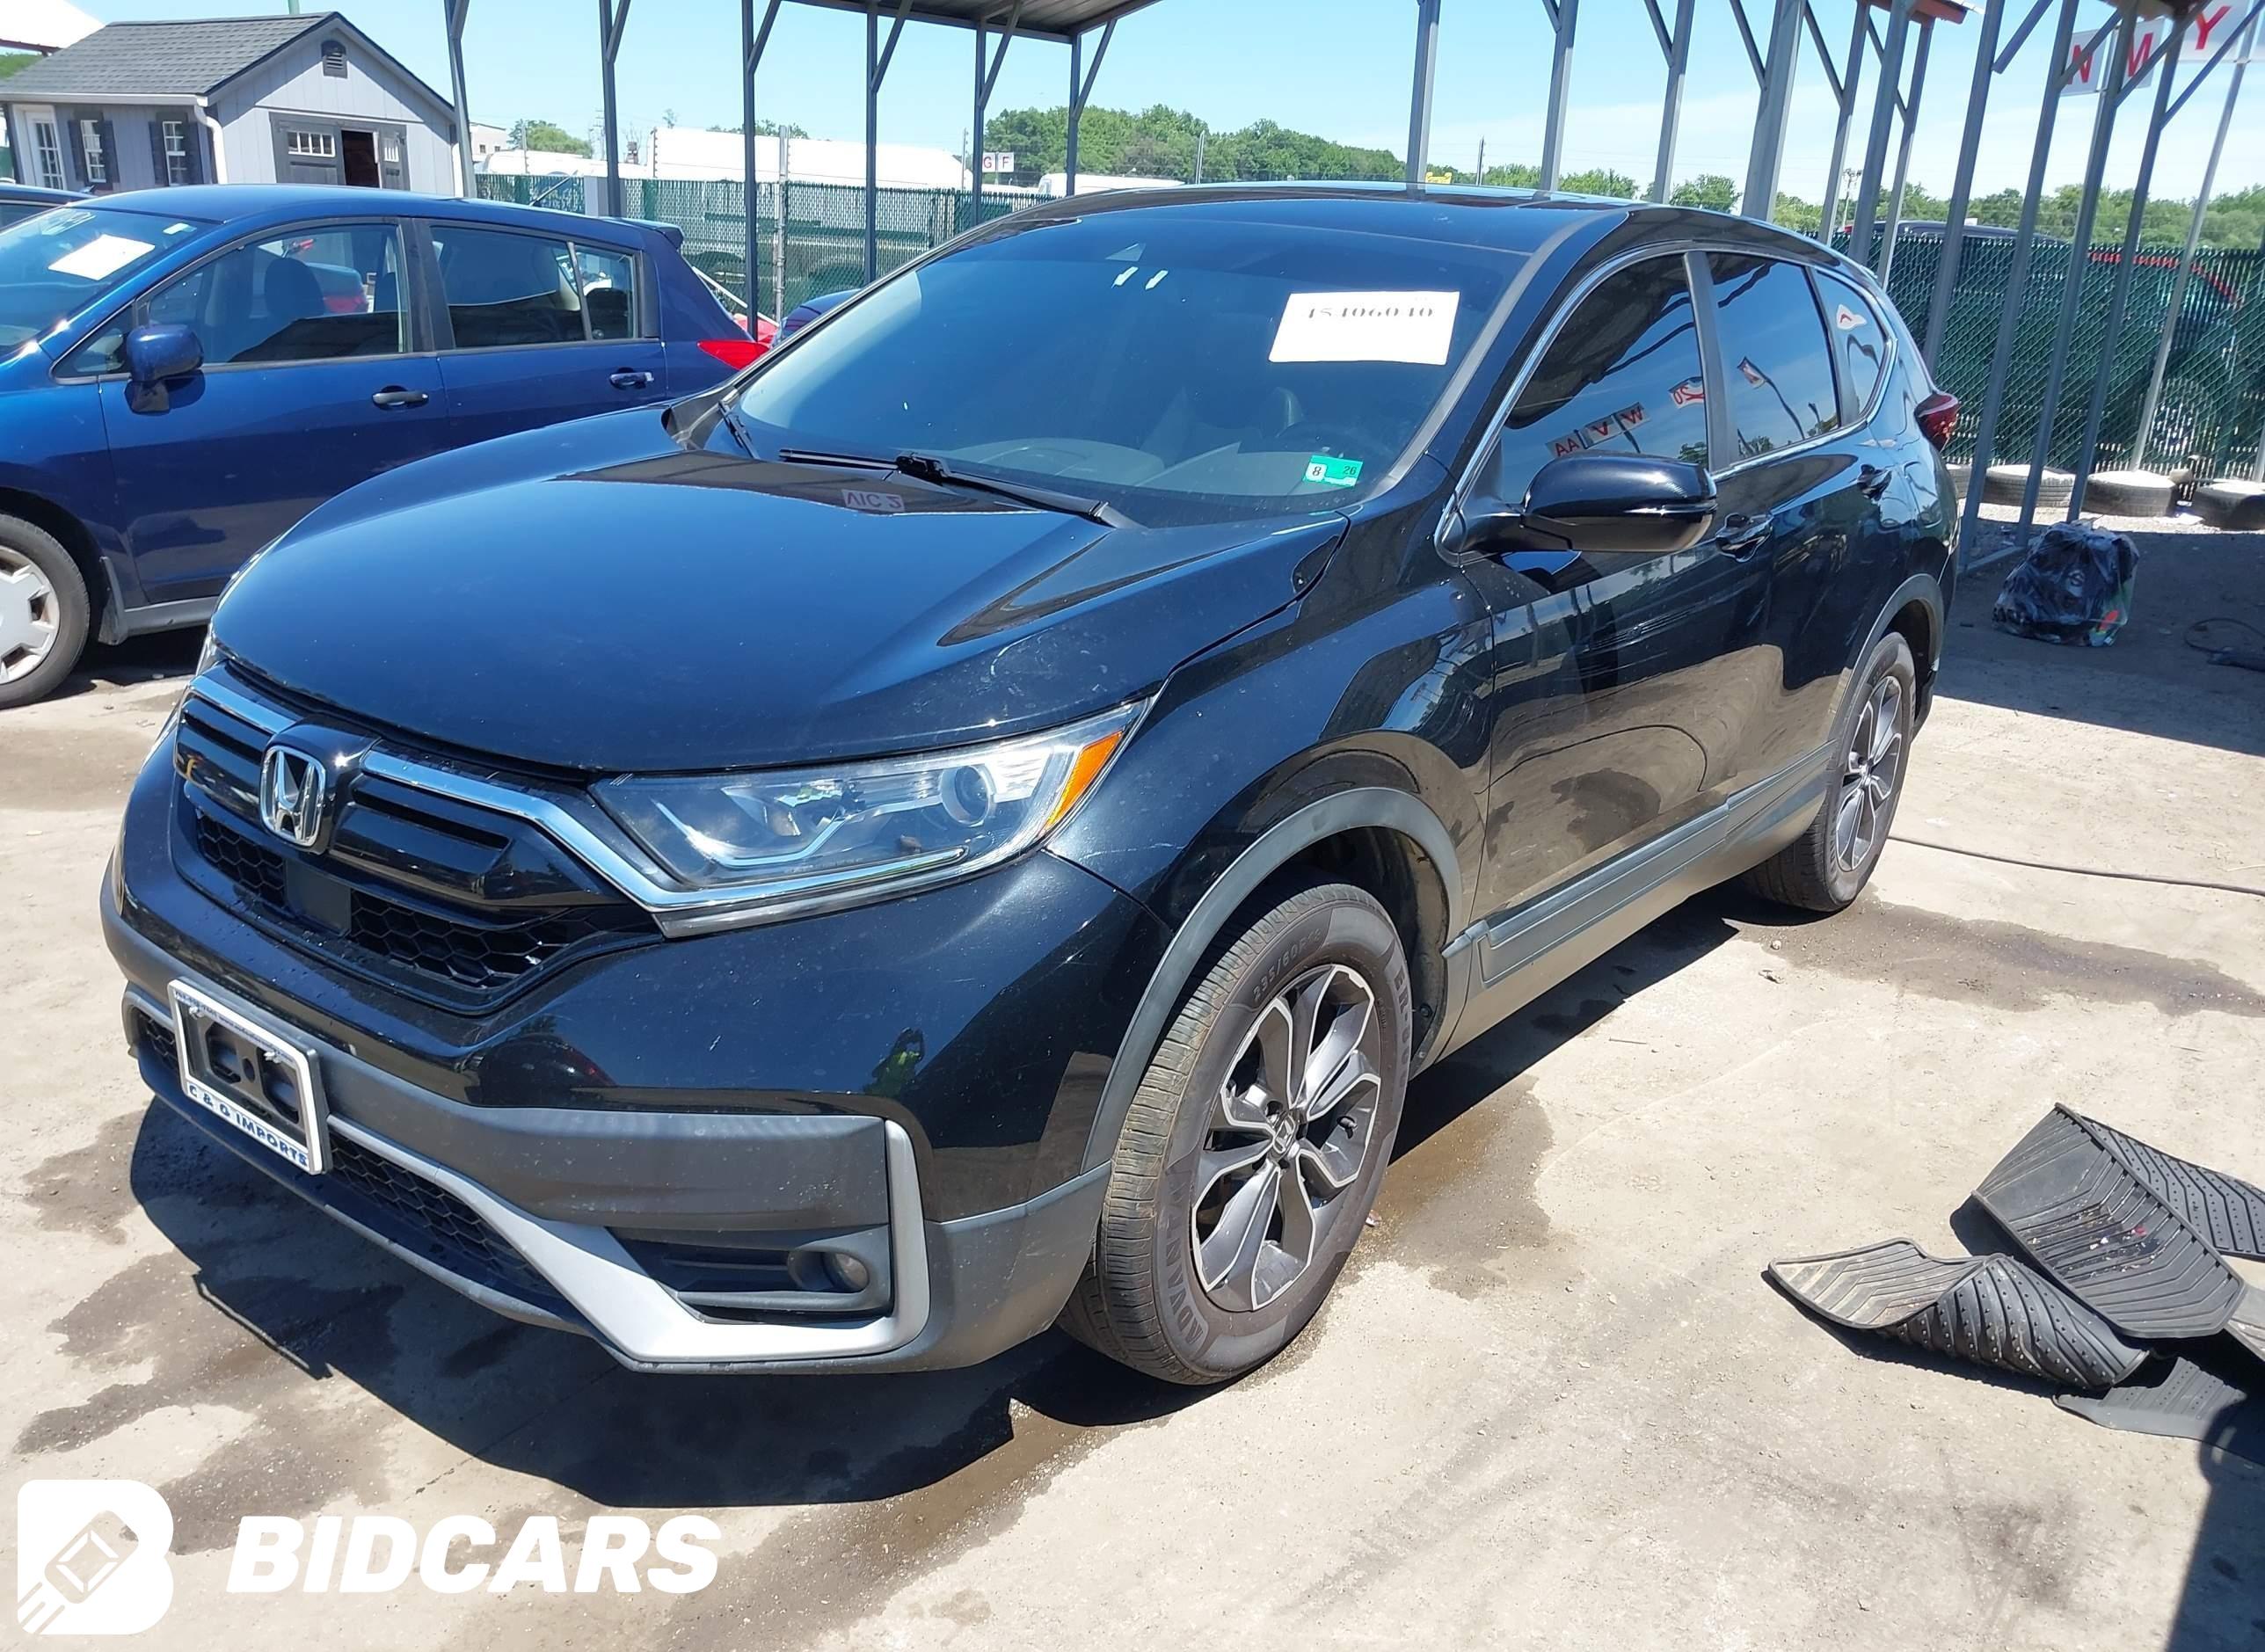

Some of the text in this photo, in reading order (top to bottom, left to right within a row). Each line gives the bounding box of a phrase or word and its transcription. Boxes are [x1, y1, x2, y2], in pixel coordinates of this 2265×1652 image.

[983, 156, 993, 169] G
[1002, 156, 1009, 169] F
[1312, 465, 1358, 477] 8 26
[189, 1085, 198, 1098] C
[203, 1094, 213, 1108] &
[236, 1113, 308, 1167] IMPORTS
